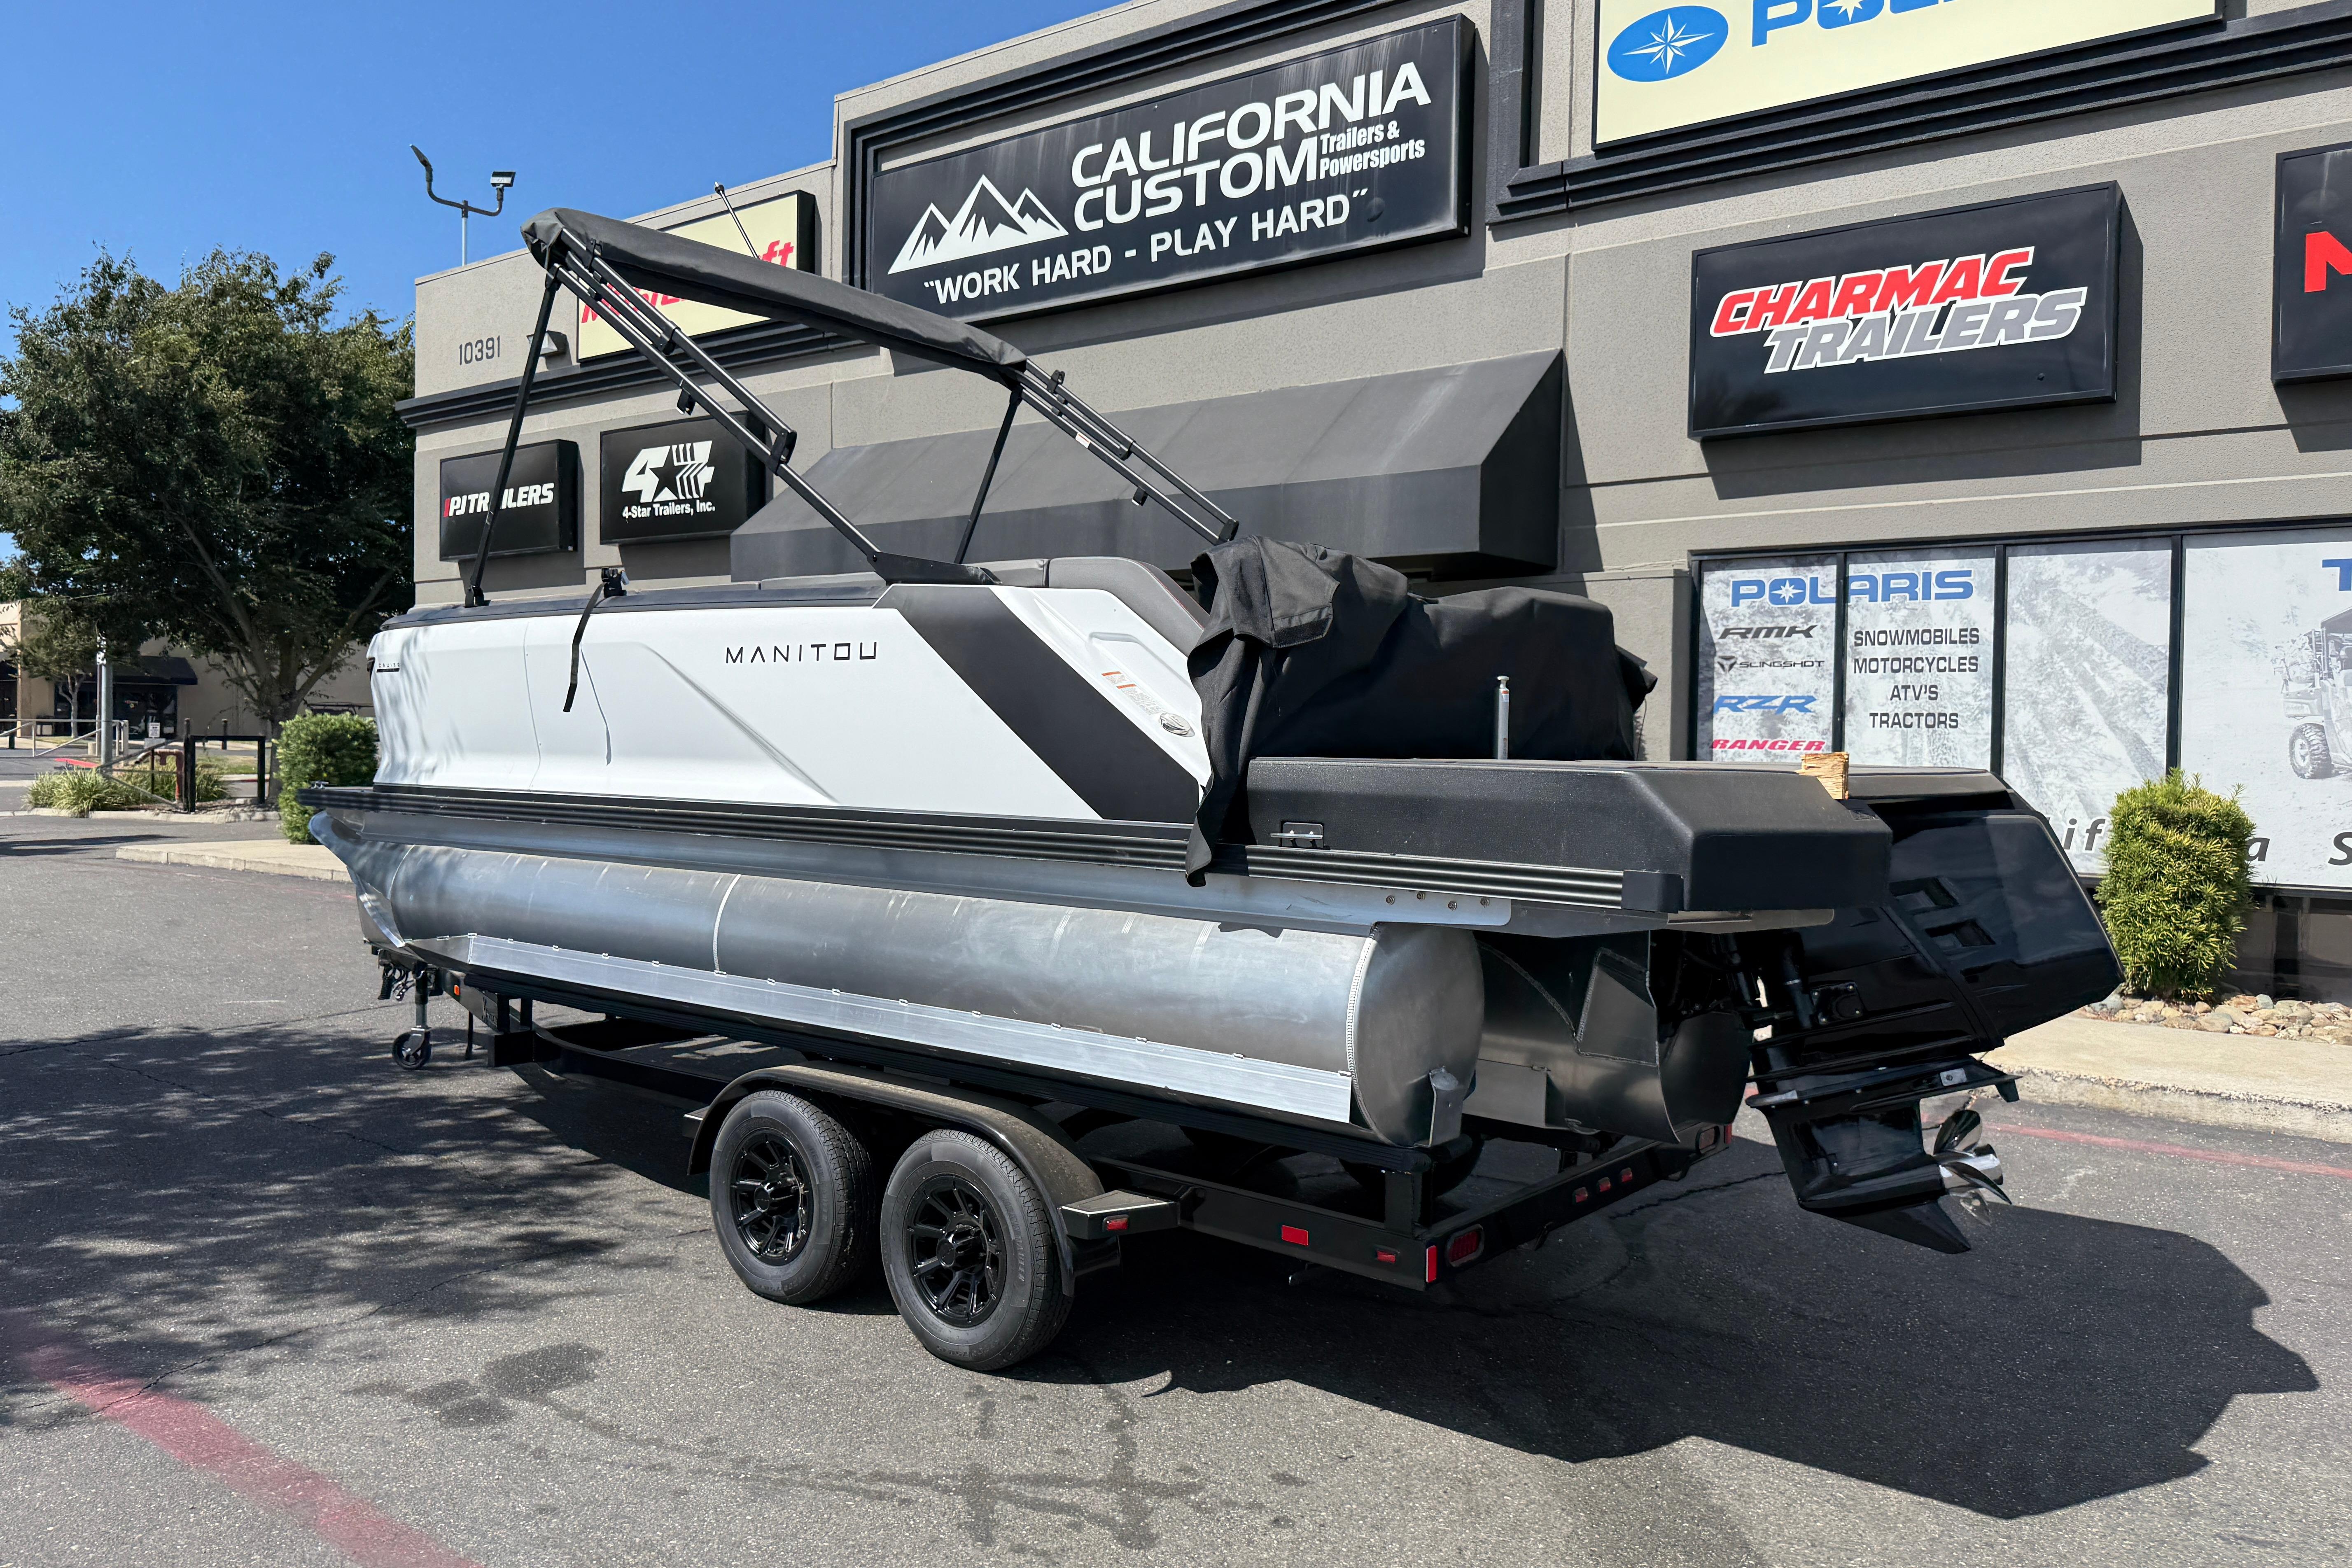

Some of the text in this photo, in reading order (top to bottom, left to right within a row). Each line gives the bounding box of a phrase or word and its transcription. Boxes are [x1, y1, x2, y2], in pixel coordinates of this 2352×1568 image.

[1071, 61, 1432, 187] CALIFORNIA
[1320, 120, 1400, 155] Trailers &
[1320, 139, 1425, 180] Powersports
[1074, 136, 1318, 231] CUSTOM
[1032, 245, 1111, 286] HARD
[1150, 216, 1238, 262] PLAY
[1711, 247, 2034, 337] CHARMAC
[1765, 288, 2086, 373] TRAILERS
[459, 335, 500, 366] 10391
[468, 483, 554, 513] TRILERS
[622, 499, 716, 518] 4-Star Trailers, Inc.
[1731, 569, 1974, 607] POLARIS
[1718, 625, 1818, 639] RMK
[1854, 628, 1979, 646] SNOWMOBILES
[726, 642, 877, 663] MANITOU
[1854, 656, 1979, 674] MOTORCYCLES
[1714, 695, 1817, 714] RZR
[1890, 685, 1939, 700] ATV'S
[1869, 712, 1959, 728] TRACTORS
[1713, 739, 1825, 751] RANGER
